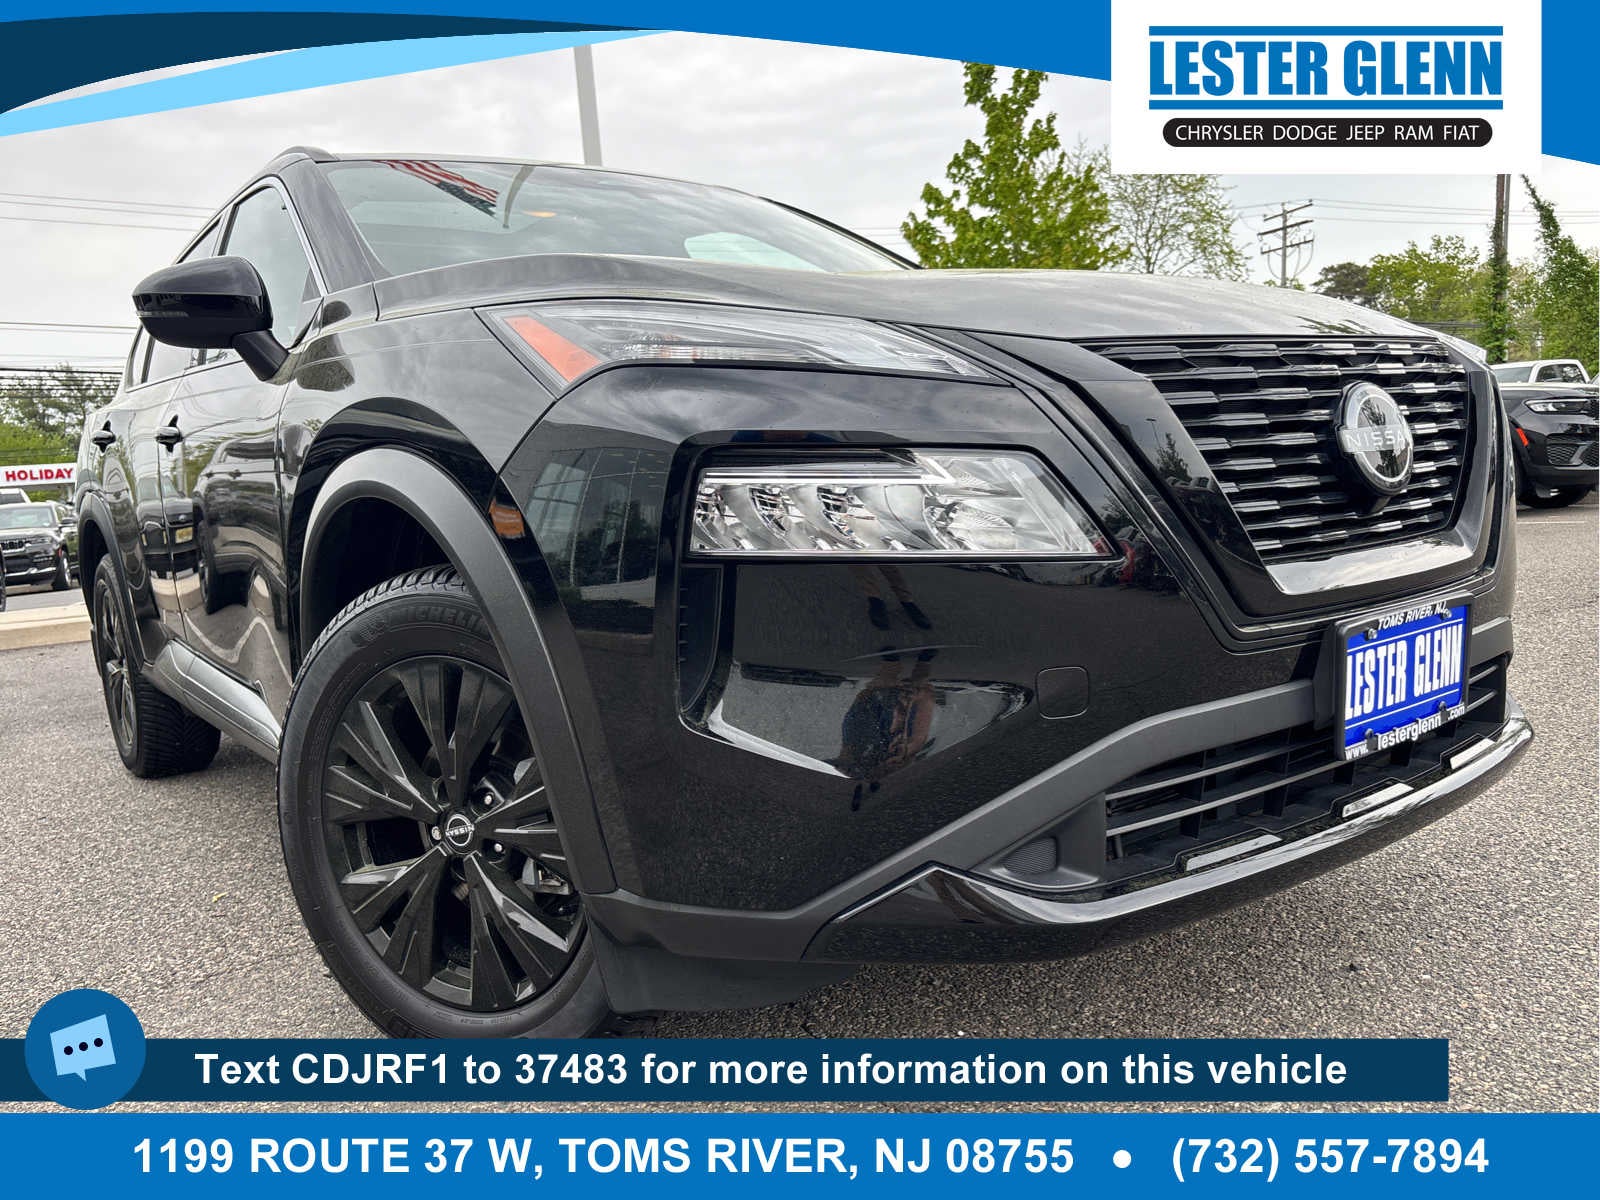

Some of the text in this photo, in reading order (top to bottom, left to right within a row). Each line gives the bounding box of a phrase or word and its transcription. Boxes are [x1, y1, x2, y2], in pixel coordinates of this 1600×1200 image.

[5, 468, 73, 482] HOLIDAY
[1378, 612, 1404, 630] TOMS
[1345, 624, 1463, 720] LESTER GLENN
